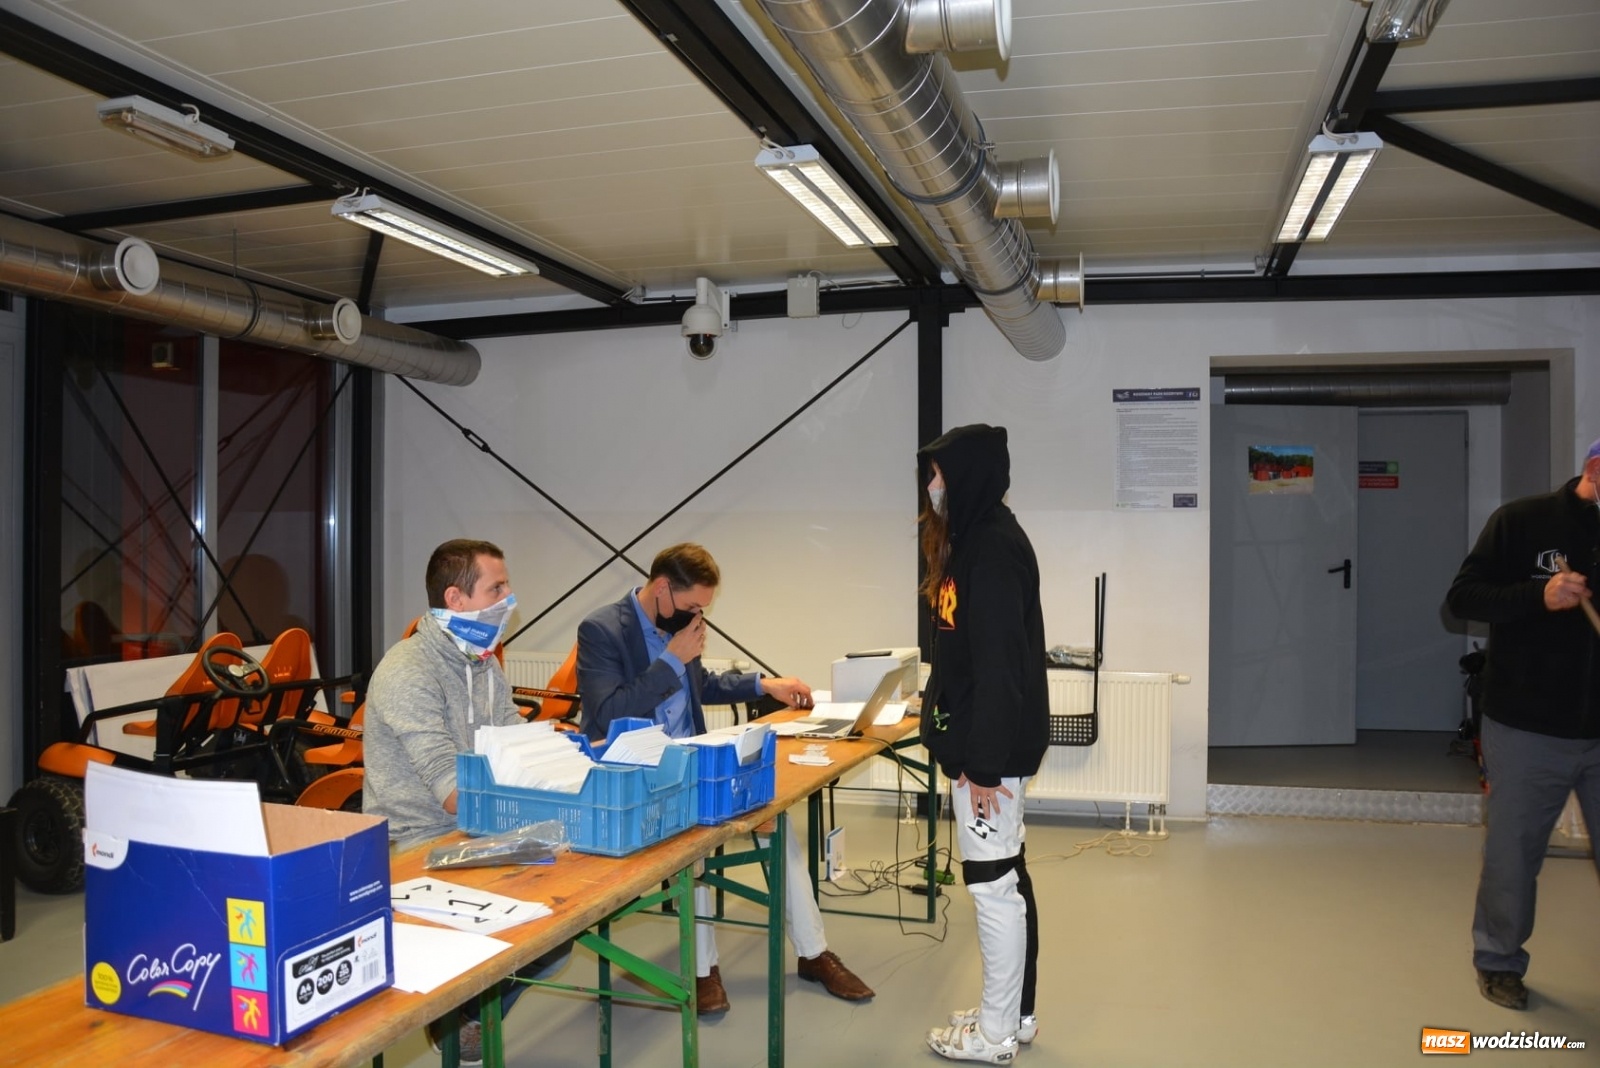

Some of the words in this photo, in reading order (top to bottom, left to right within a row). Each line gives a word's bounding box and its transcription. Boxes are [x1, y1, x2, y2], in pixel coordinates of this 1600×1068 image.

[127, 953, 170, 985] Color
[171, 943, 221, 1011] Copy
[318, 972, 333, 988] 200
[299, 982, 312, 996] A4
